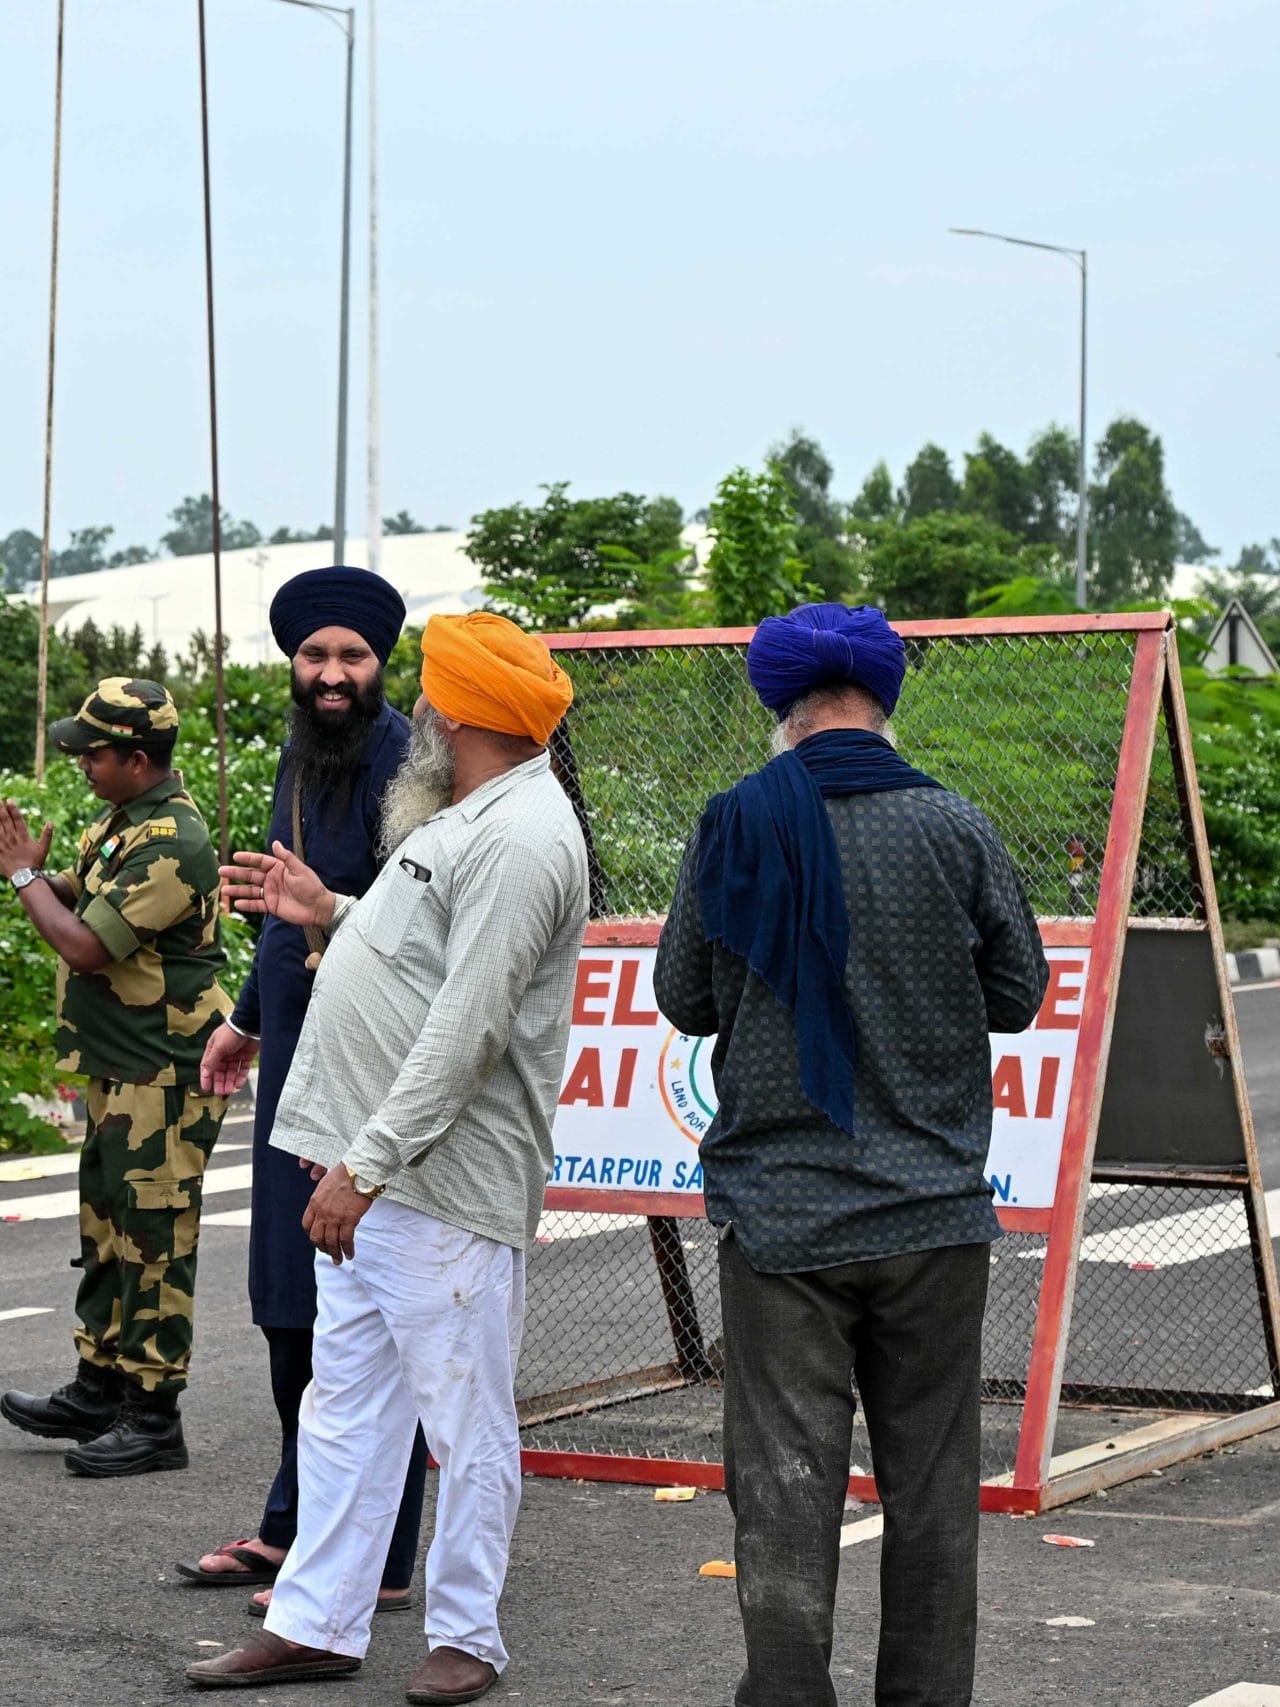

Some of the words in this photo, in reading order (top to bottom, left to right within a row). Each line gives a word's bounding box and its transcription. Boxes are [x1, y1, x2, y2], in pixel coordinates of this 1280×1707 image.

[571, 959, 659, 1026] EL
[558, 1047, 638, 1108] AI
[671, 1080, 688, 1108] LAND
[684, 1111, 706, 1132] POR
[549, 1155, 662, 1187] RTARPUR
